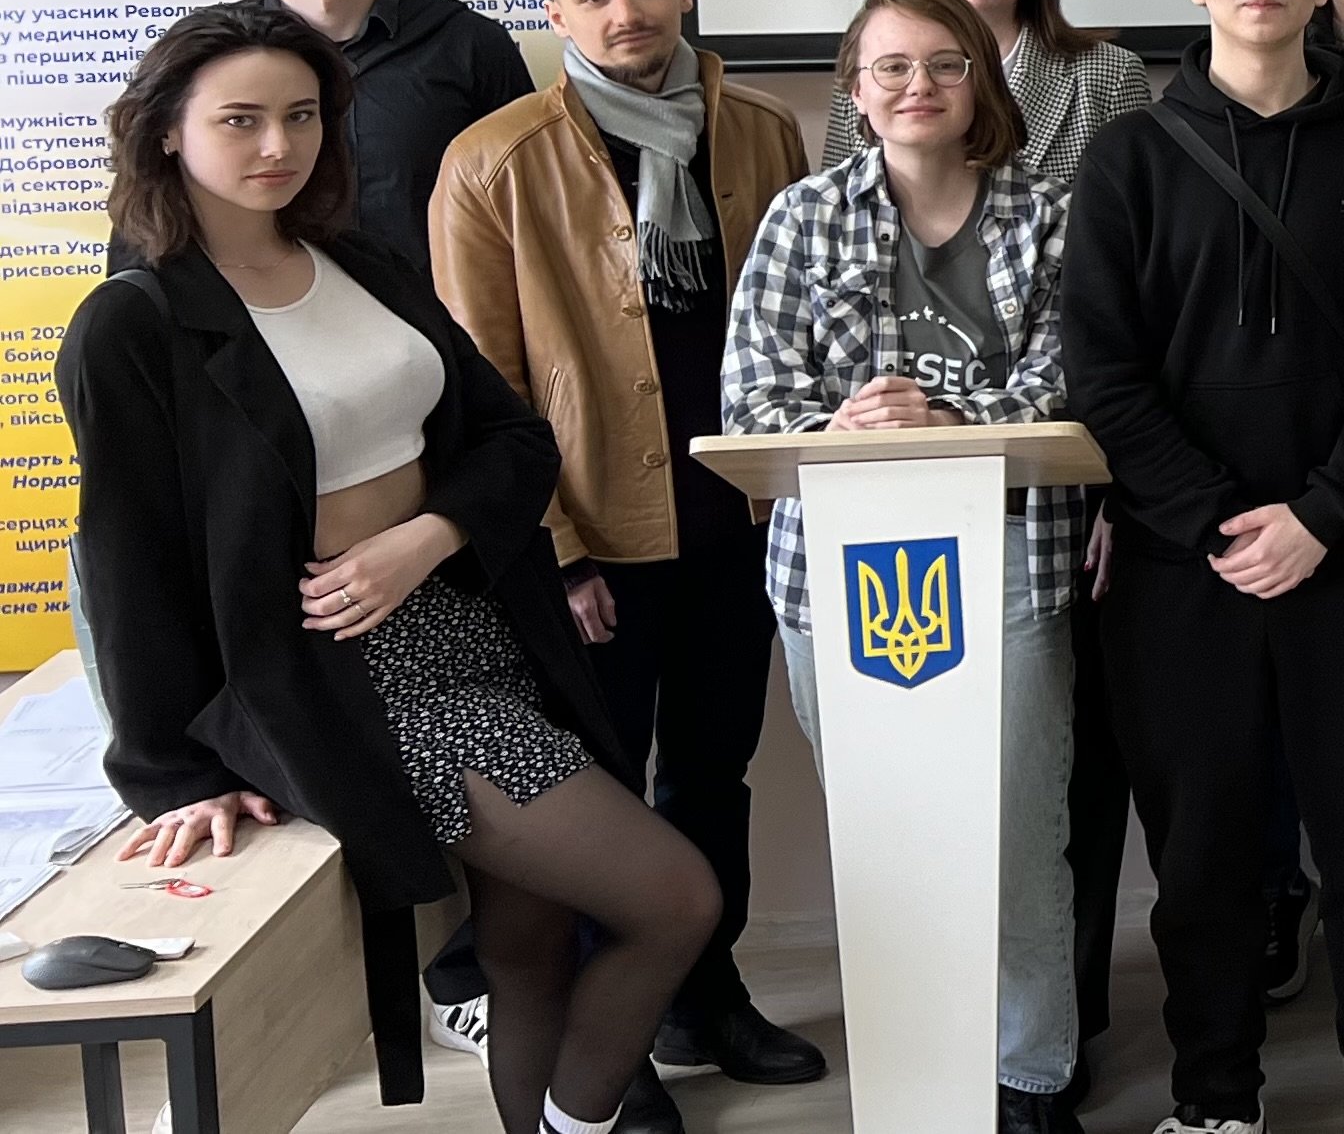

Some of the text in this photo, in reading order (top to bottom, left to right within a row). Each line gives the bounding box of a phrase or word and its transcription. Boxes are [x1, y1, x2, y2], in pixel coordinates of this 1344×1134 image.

[32, 6, 119, 23] учасник
[18, 26, 139, 43] медичному
[14, 49, 96, 66] перших
[7, 70, 68, 85] пішов
[1, 113, 97, 131] мужність
[0, 156, 113, 173] Доброволе
[21, 179, 109, 194] сектор».
[66, 240, 111, 258] Укр
[31, 326, 66, 341] 202
[4, 347, 59, 363] бойо
[10, 410, 64, 426] війсь
[12, 474, 80, 491] Норда
